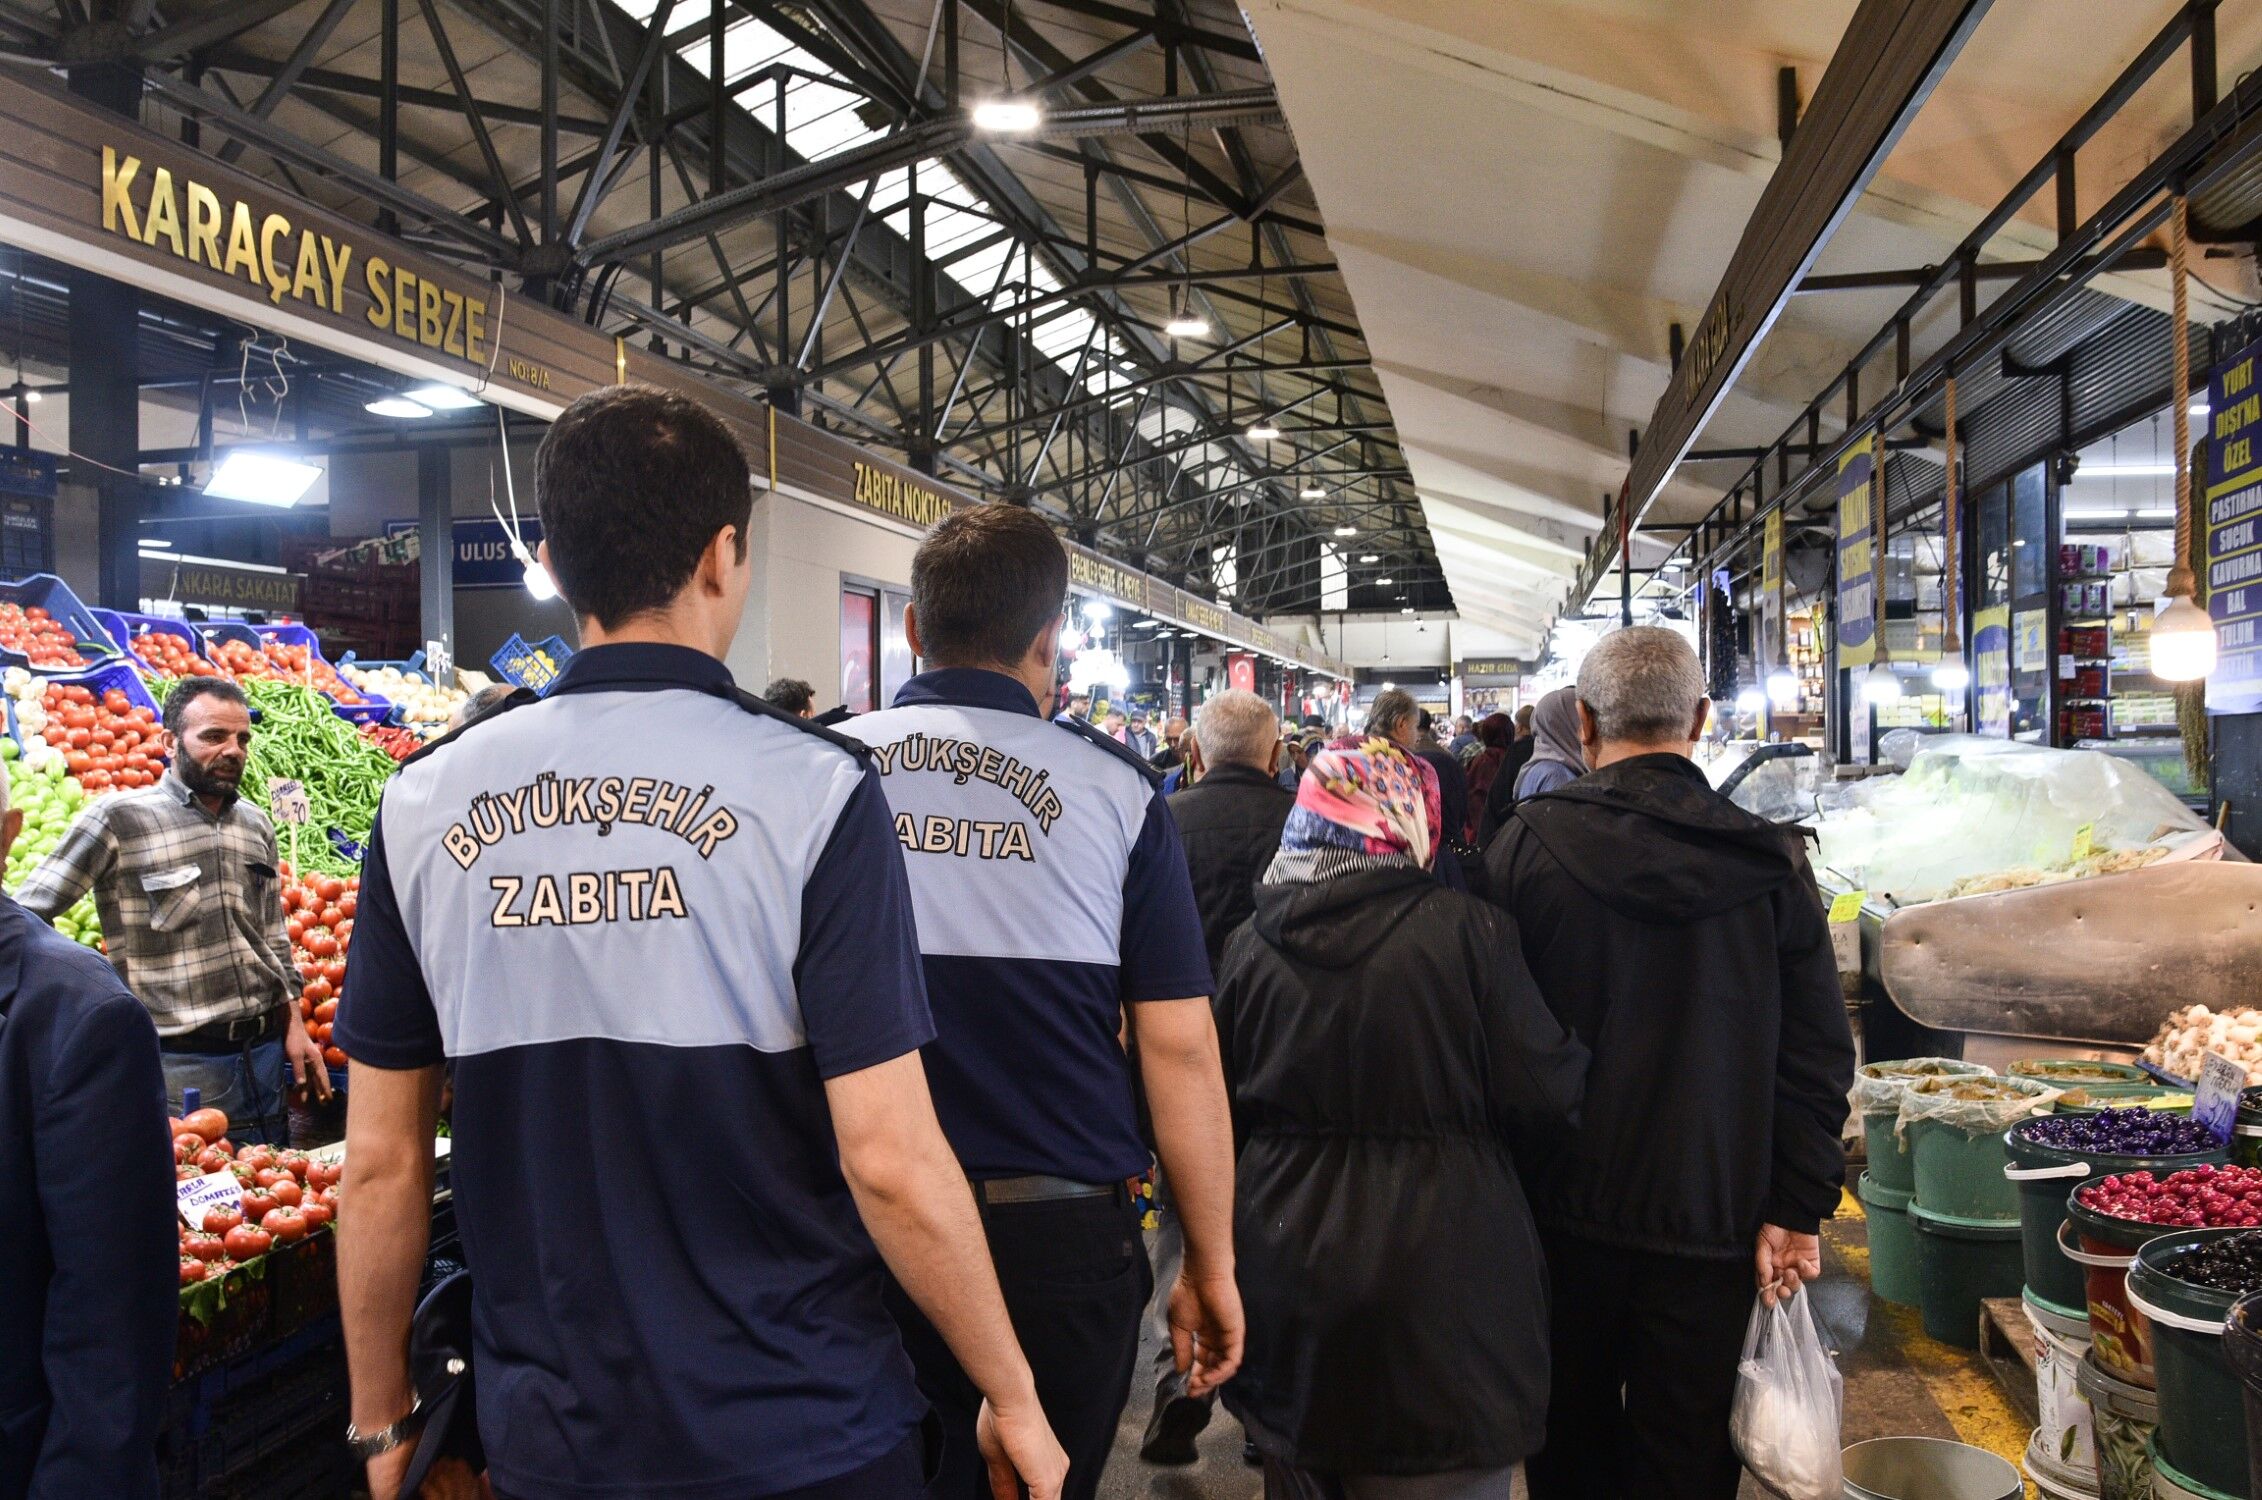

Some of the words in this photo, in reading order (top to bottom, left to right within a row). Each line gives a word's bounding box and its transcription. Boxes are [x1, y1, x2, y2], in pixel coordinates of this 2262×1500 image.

[102, 145, 352, 314] KARAÇAY
[366, 256, 485, 364] SEBZE
[2223, 357, 2254, 399] YURT
[2223, 437, 2252, 473] ÖZEL
[854, 461, 901, 516] ZABITA
[903, 482, 951, 526] NOKTASI
[2211, 485, 2262, 524] PASTIRMA
[460, 542, 506, 562] ULUS
[2219, 521, 2254, 552] SUCUK
[2212, 552, 2262, 586] KAVURMA
[169, 572, 233, 598] ANKARA
[236, 577, 300, 604] SAKATAT
[2227, 589, 2246, 614] BAL
[2219, 620, 2254, 647] TULUM
[1467, 663, 1495, 674] HAZIR
[1497, 663, 1518, 673] GIDA
[873, 732, 1062, 837] YÜKŞEHİR
[441, 771, 738, 871] BÜYÜKŞEHİR
[895, 812, 1036, 863] ABITA
[490, 866, 688, 928] ZABITA
[177, 1178, 206, 1198] ARLA
